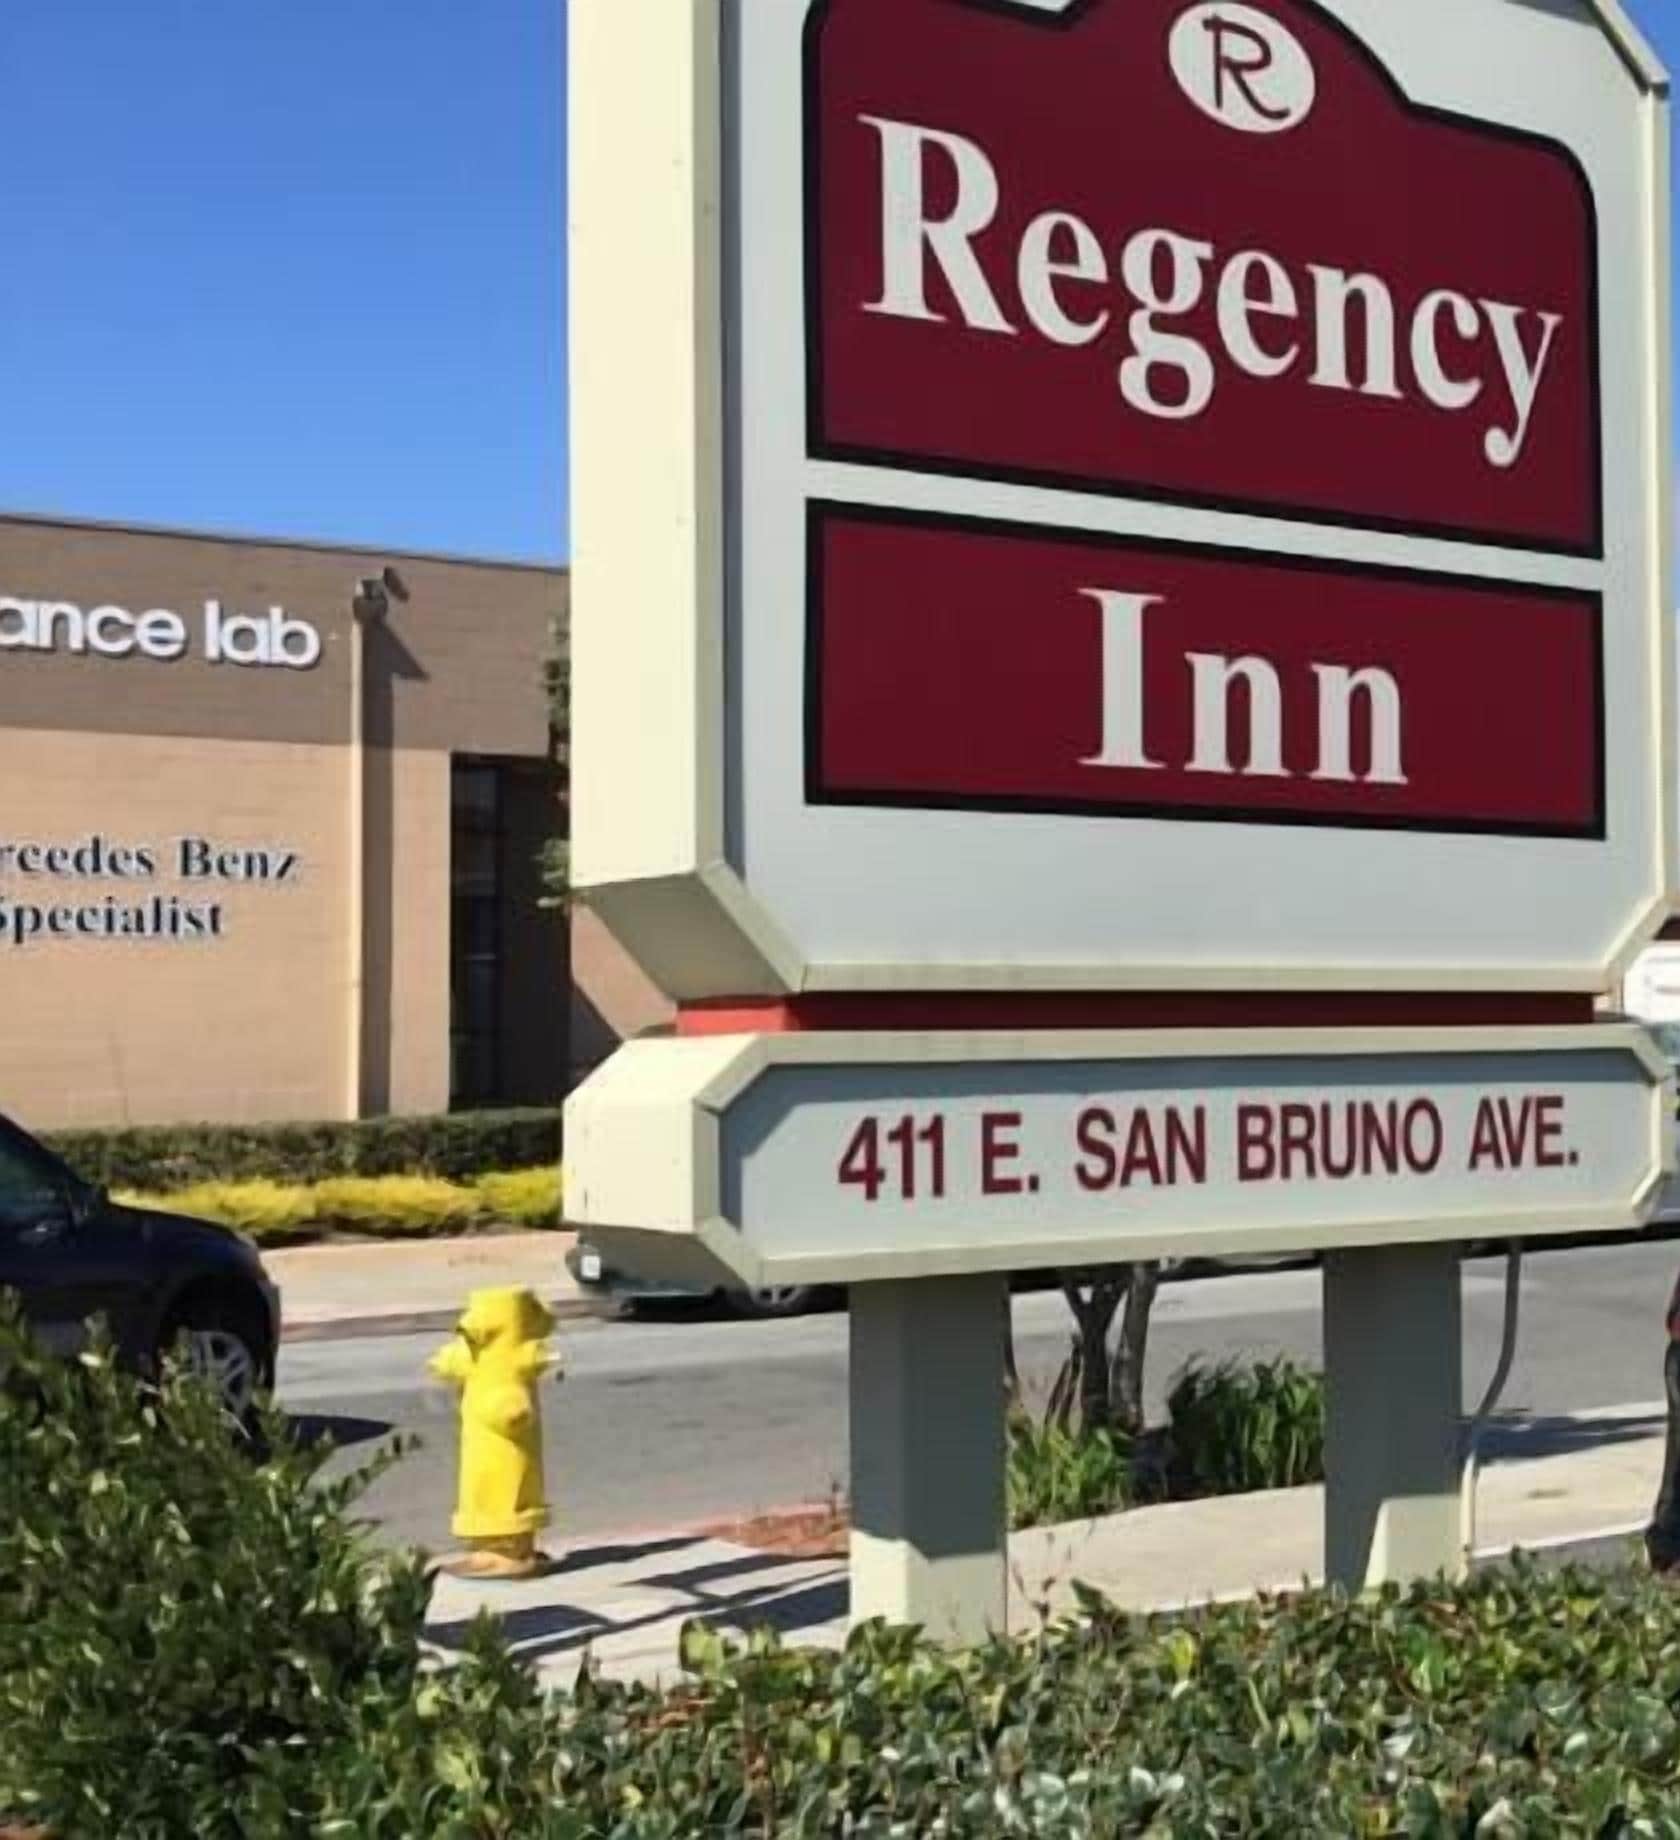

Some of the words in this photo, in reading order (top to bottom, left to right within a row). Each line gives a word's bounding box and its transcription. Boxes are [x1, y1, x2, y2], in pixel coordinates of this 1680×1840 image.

[857, 113, 1563, 468] Regency
[0, 596, 187, 657] ance
[204, 599, 321, 666] lab
[1077, 586, 1409, 785] Inn
[179, 838, 297, 881] Benz
[837, 1112, 945, 1202] 411
[980, 1110, 1041, 1196] E.
[1073, 1104, 1208, 1193] SAN
[1236, 1096, 1444, 1183] BRUNO
[1467, 1093, 1580, 1172] AVE.
